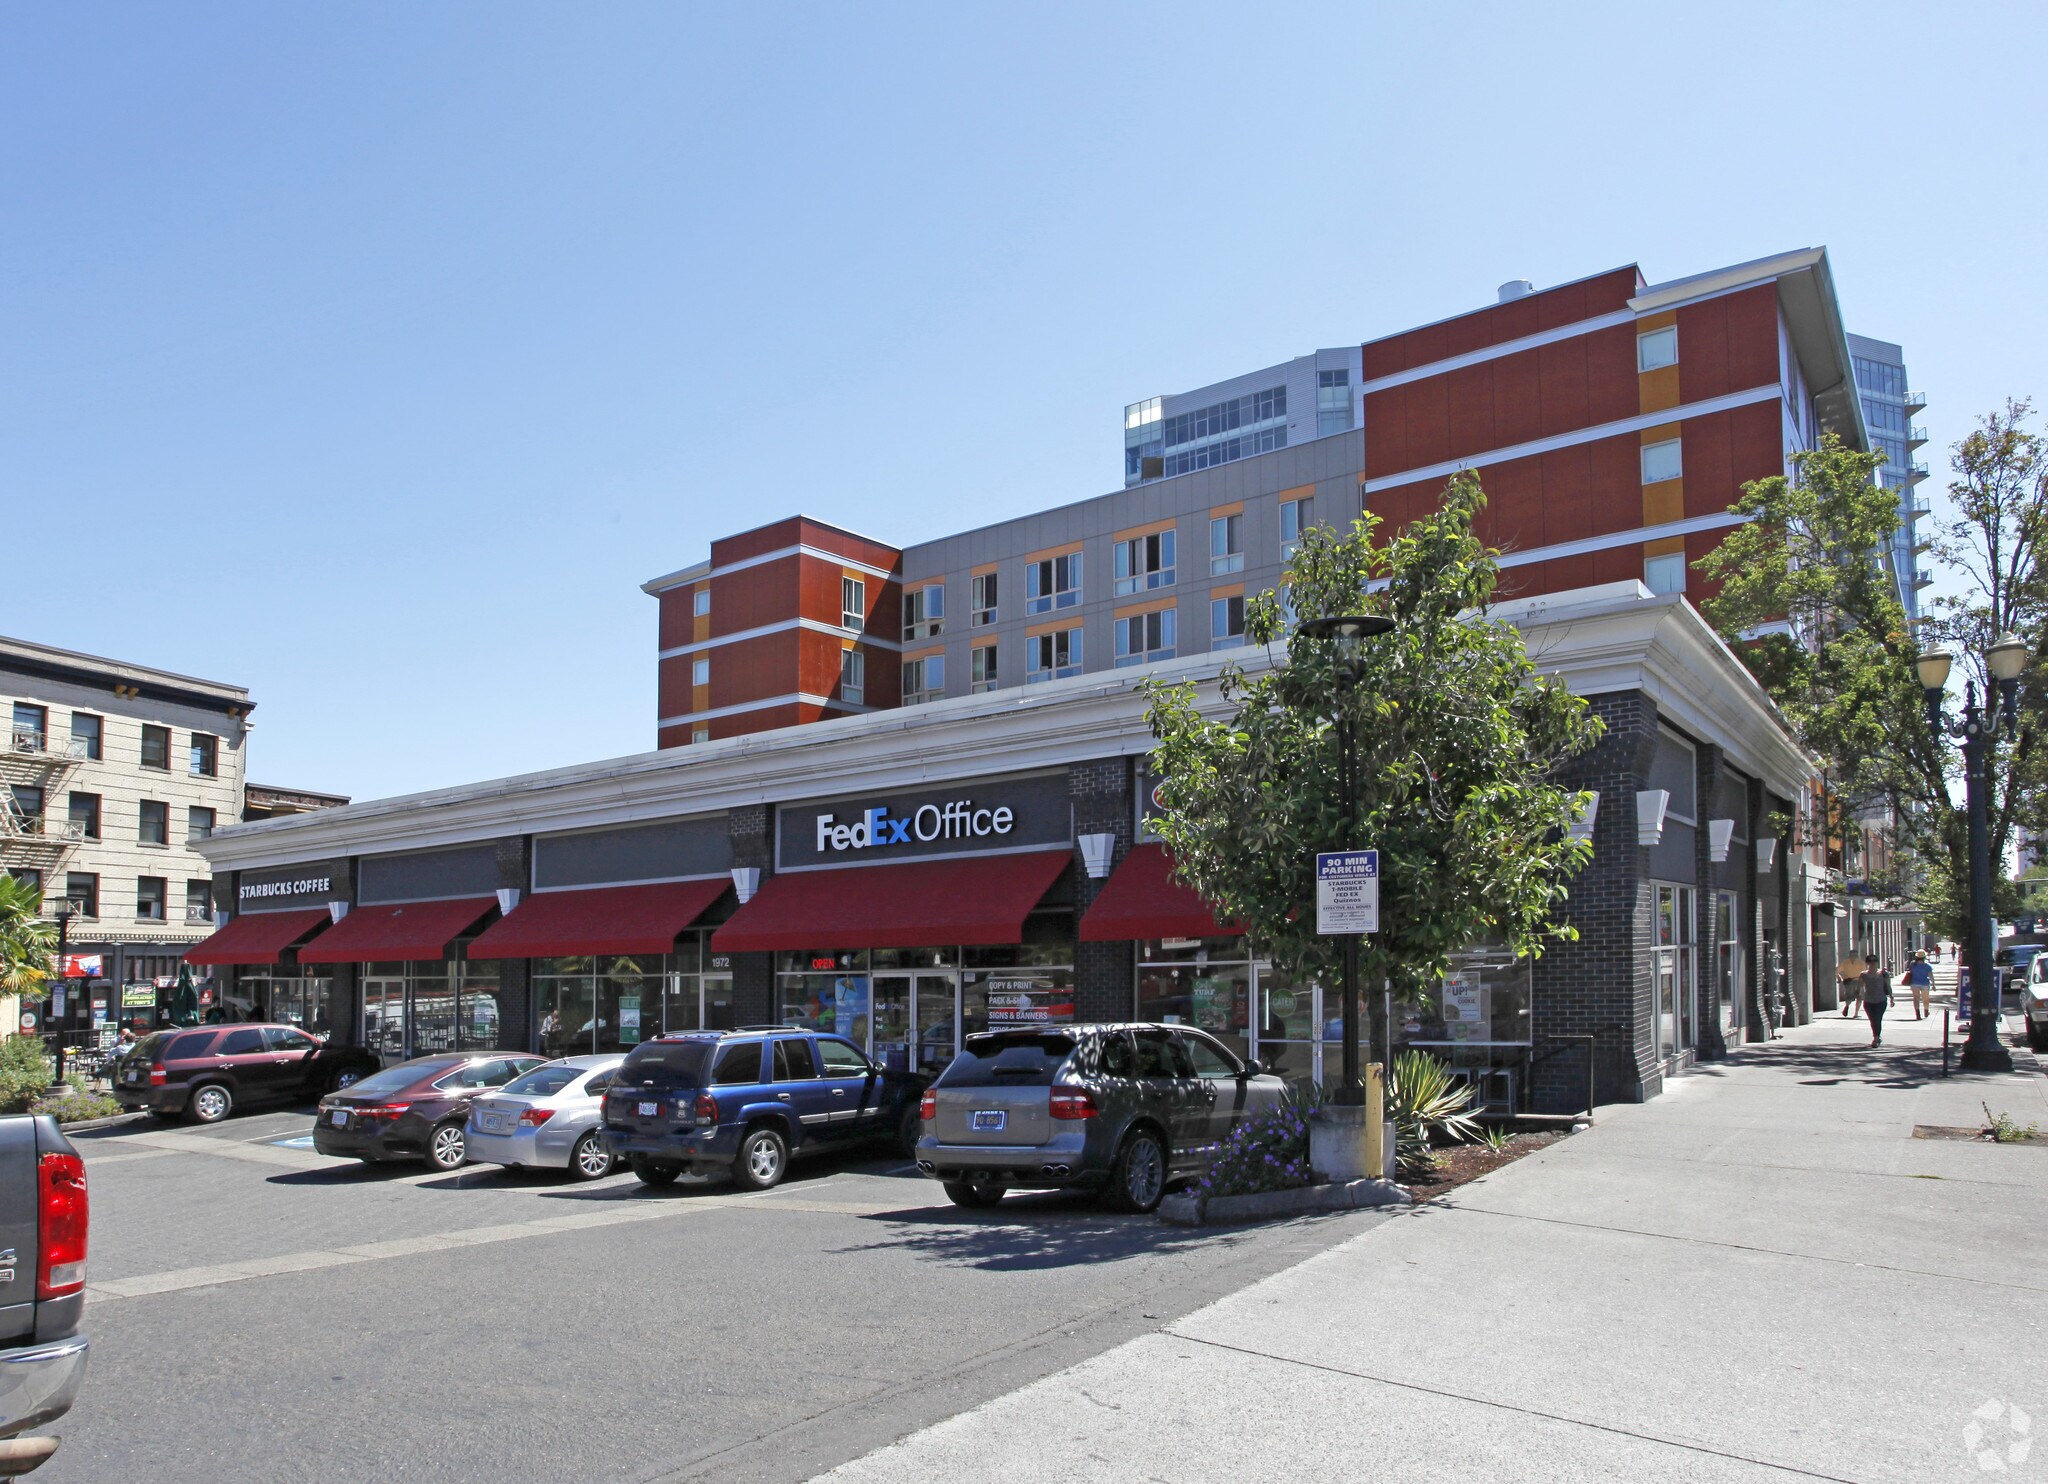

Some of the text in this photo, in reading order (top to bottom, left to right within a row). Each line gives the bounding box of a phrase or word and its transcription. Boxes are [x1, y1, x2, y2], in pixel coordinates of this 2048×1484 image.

[817, 800, 1013, 851] FedEx Office
[1345, 857, 1368, 865] MIN
[1322, 865, 1373, 875] PARKING
[239, 878, 330, 899] STARBUCKS COFFEE
[712, 957, 730, 968] 1972
[812, 958, 835, 970] OPEN
[989, 981, 1032, 990] COPY & PRINT
[1452, 986, 1468, 996] UP!
[989, 996, 1006, 1005] PACK
[1006, 996, 1012, 1004] &
[988, 1011, 1048, 1020] SIGNS & BANNERS
